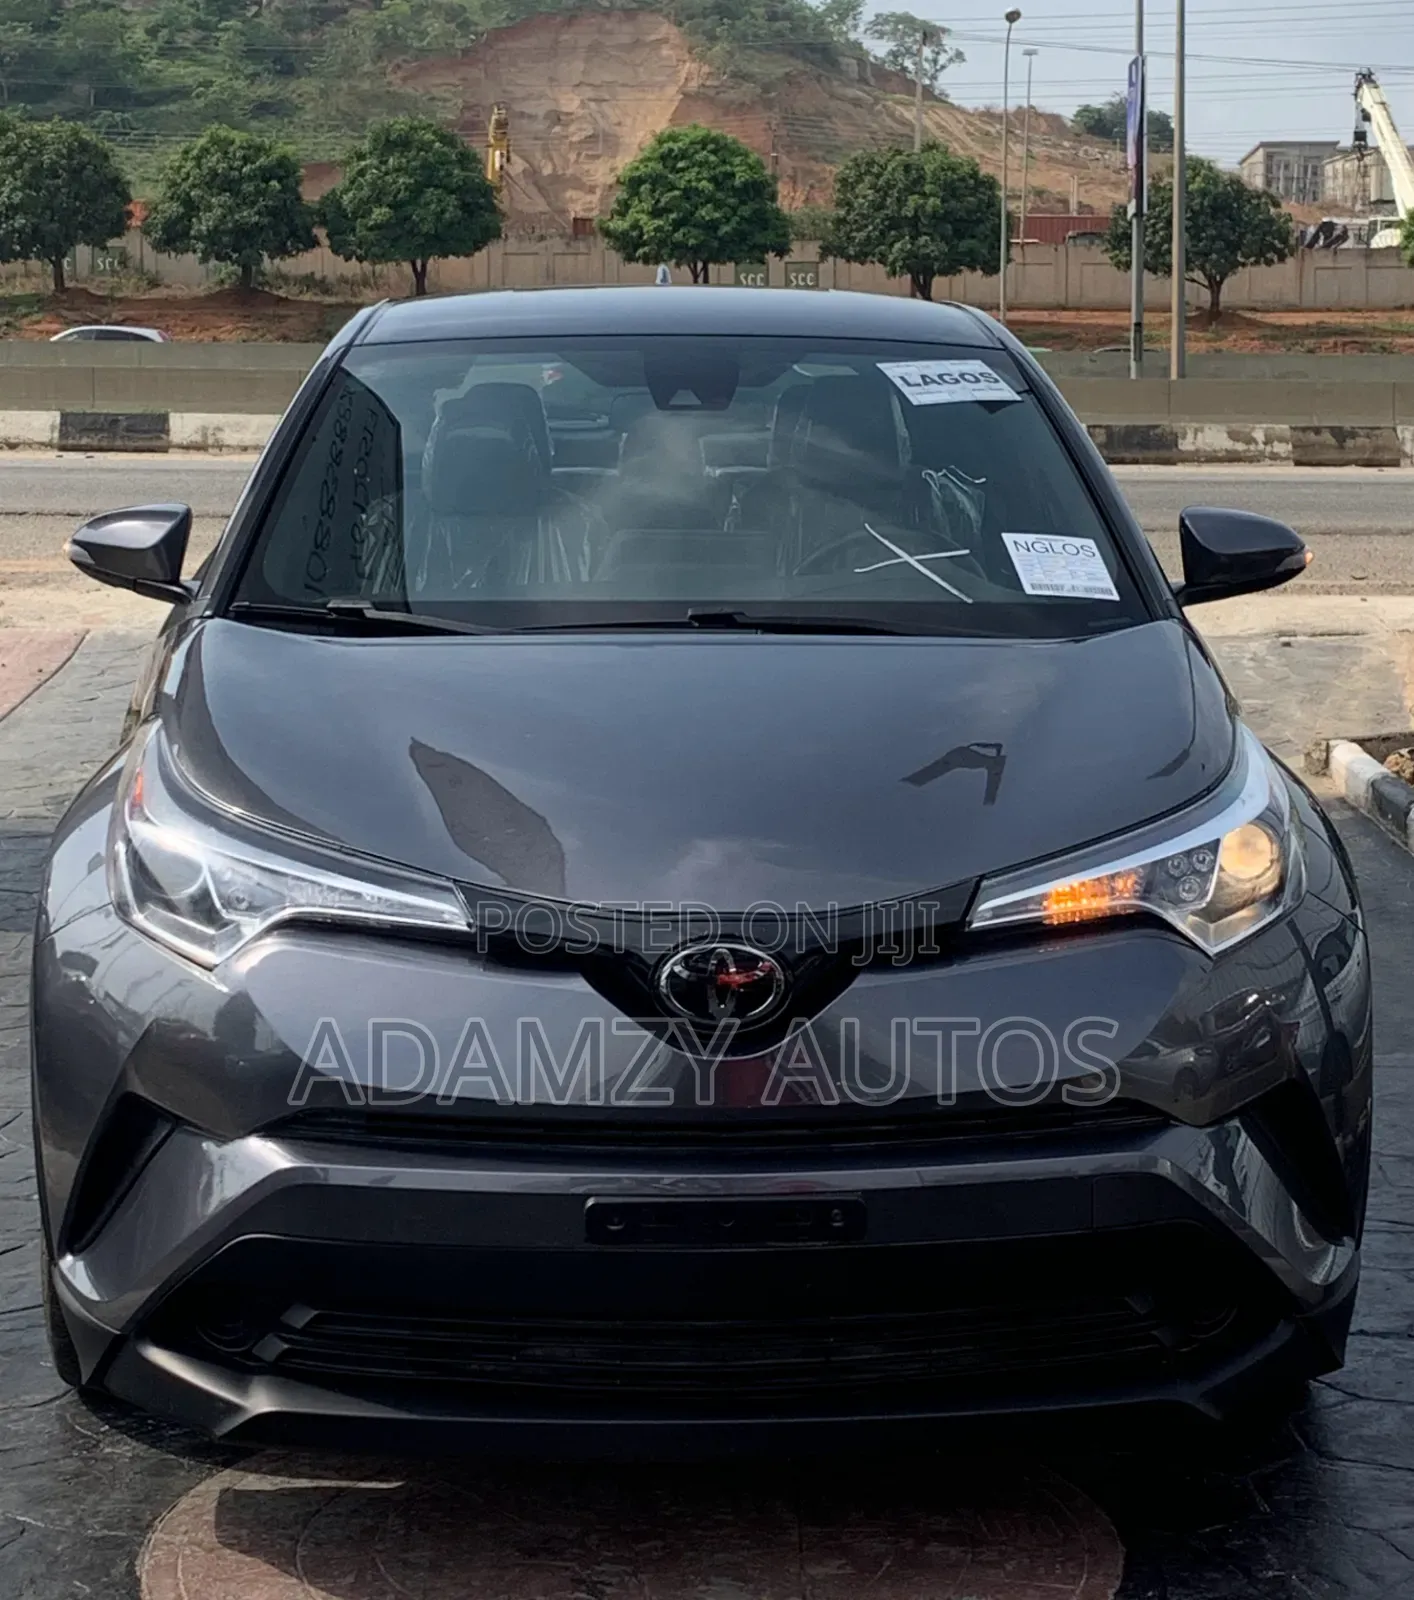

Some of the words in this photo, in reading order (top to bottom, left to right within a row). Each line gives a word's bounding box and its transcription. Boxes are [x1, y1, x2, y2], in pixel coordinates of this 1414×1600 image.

[790, 272, 815, 286] SCC
[898, 371, 1000, 388] LAGOS
[1013, 540, 1096, 558] NGLOS
